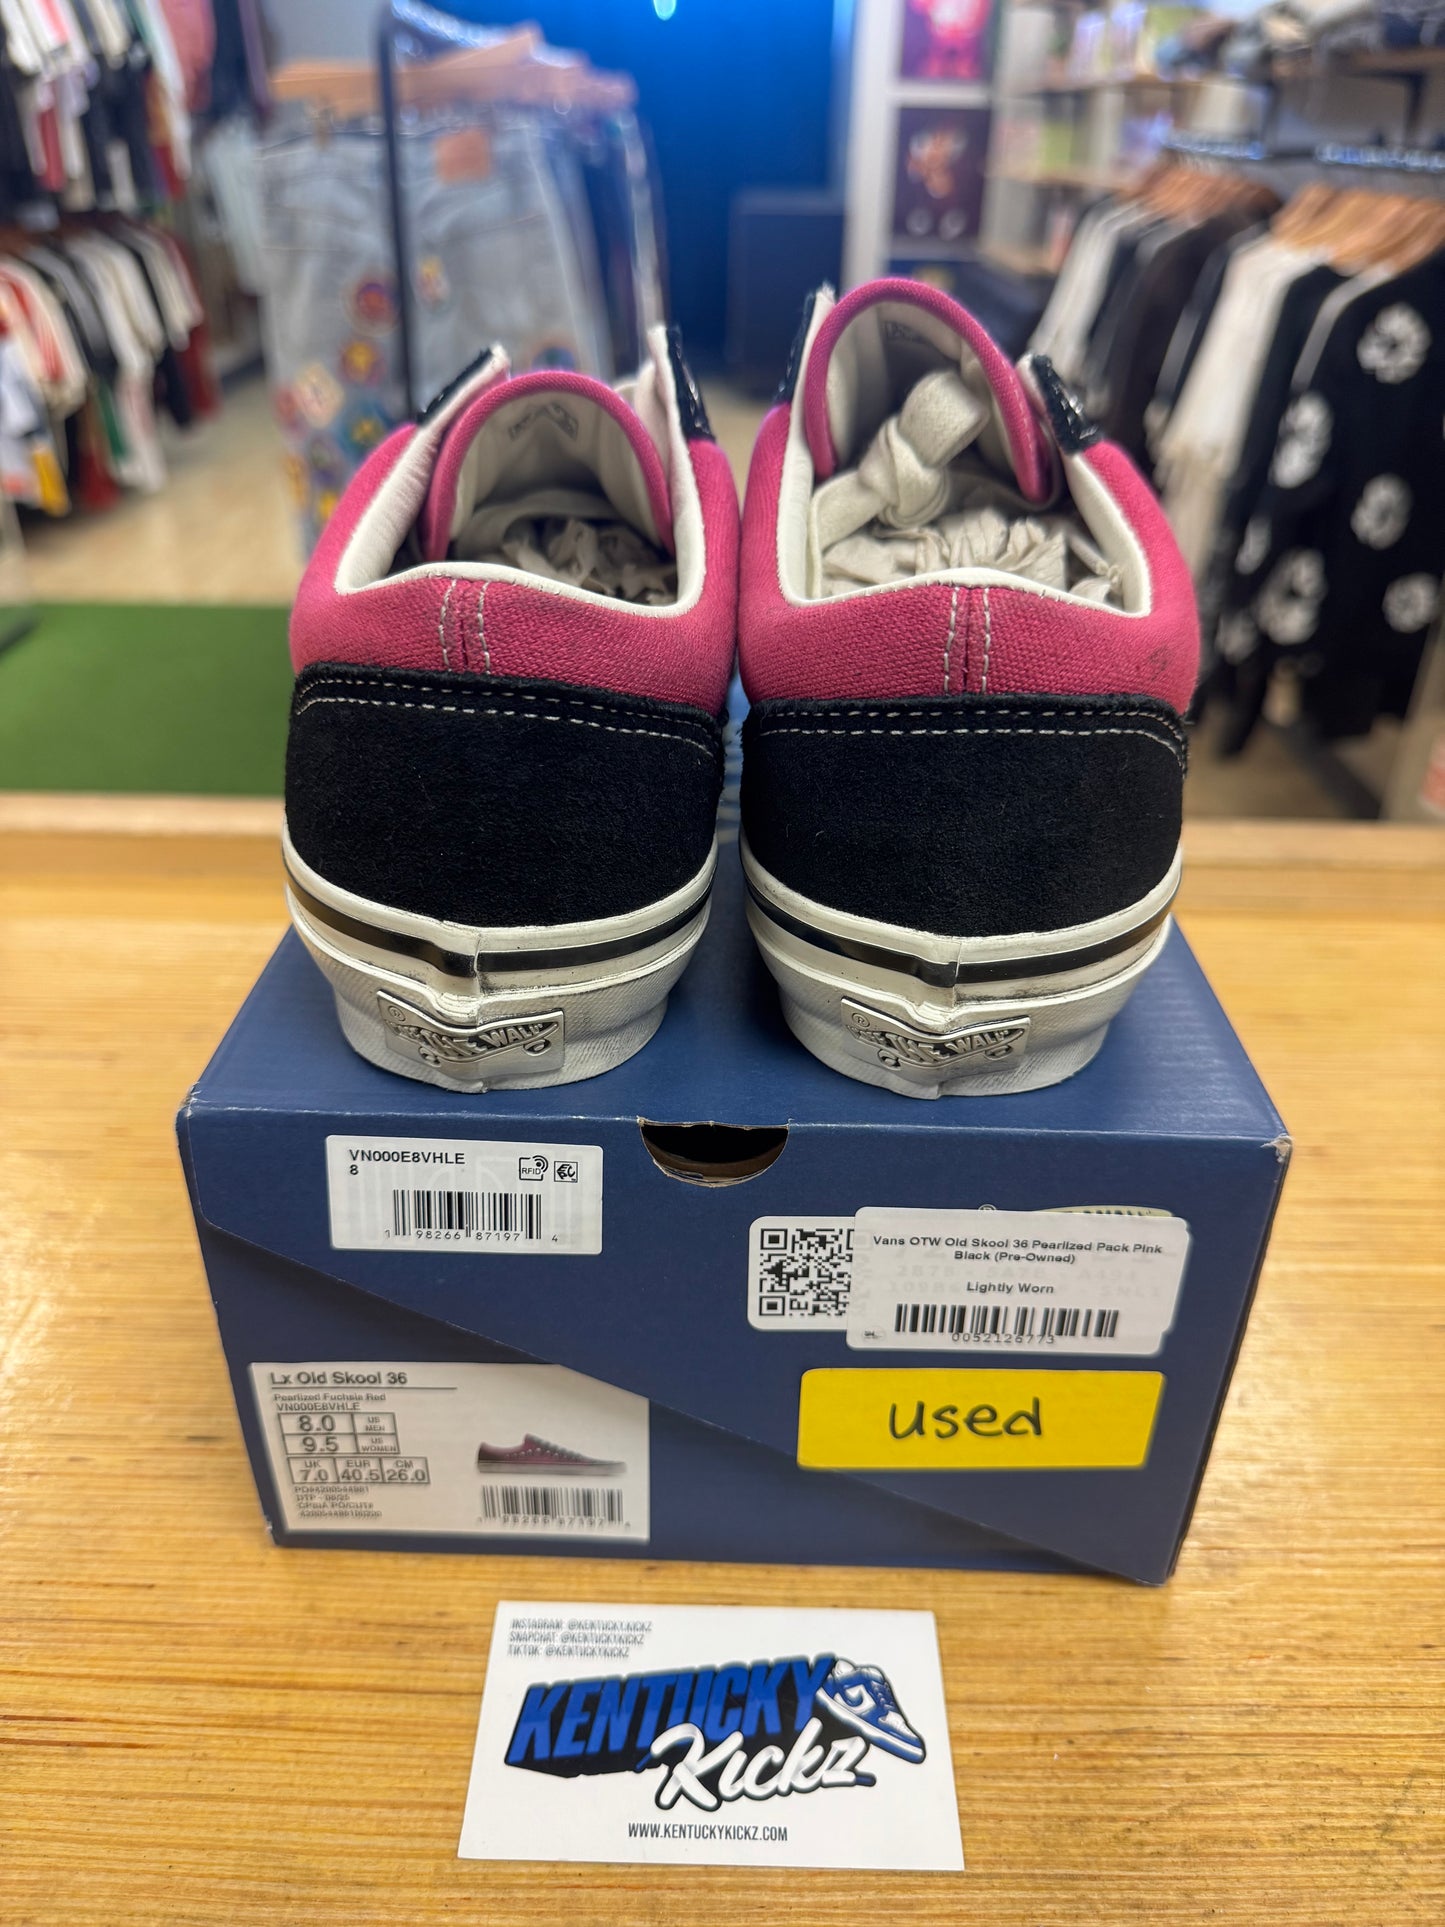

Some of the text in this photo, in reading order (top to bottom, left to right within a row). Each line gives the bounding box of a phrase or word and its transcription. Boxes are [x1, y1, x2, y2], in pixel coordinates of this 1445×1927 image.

[349, 1149, 466, 1165] VN000E8VHLE
[349, 1165, 359, 1176] 8
[521, 1167, 541, 1175] RFID
[416, 1229, 462, 1241] 98266
[475, 1231, 521, 1242] 87197
[873, 1235, 1163, 1255] Vans OTW Old Skool 36 Pearlized Pack Pink
[954, 1250, 1076, 1265] Black (Pre-Owned)
[966, 1281, 1013, 1294] Lightly
[1017, 1283, 1055, 1294] Worn
[951, 1332, 1056, 1344] 0052126773
[270, 1371, 408, 1384] Lx Old Skool 36
[366, 1393, 386, 1401] Red
[299, 1415, 336, 1432] 8.0
[302, 1436, 339, 1453] 9.5
[305, 1460, 321, 1468] UK
[346, 1460, 371, 1468] EUR
[395, 1460, 414, 1468] CM
[302, 1470, 329, 1482] 7.0
[341, 1470, 381, 1482] 40.5
[387, 1470, 426, 1482] 26.0
[507, 1655, 837, 1765] KENTUCKY
[651, 1716, 868, 1810] Kickz
[628, 1823, 788, 1842] WWW.KENTUCKYKICKZ.COM
